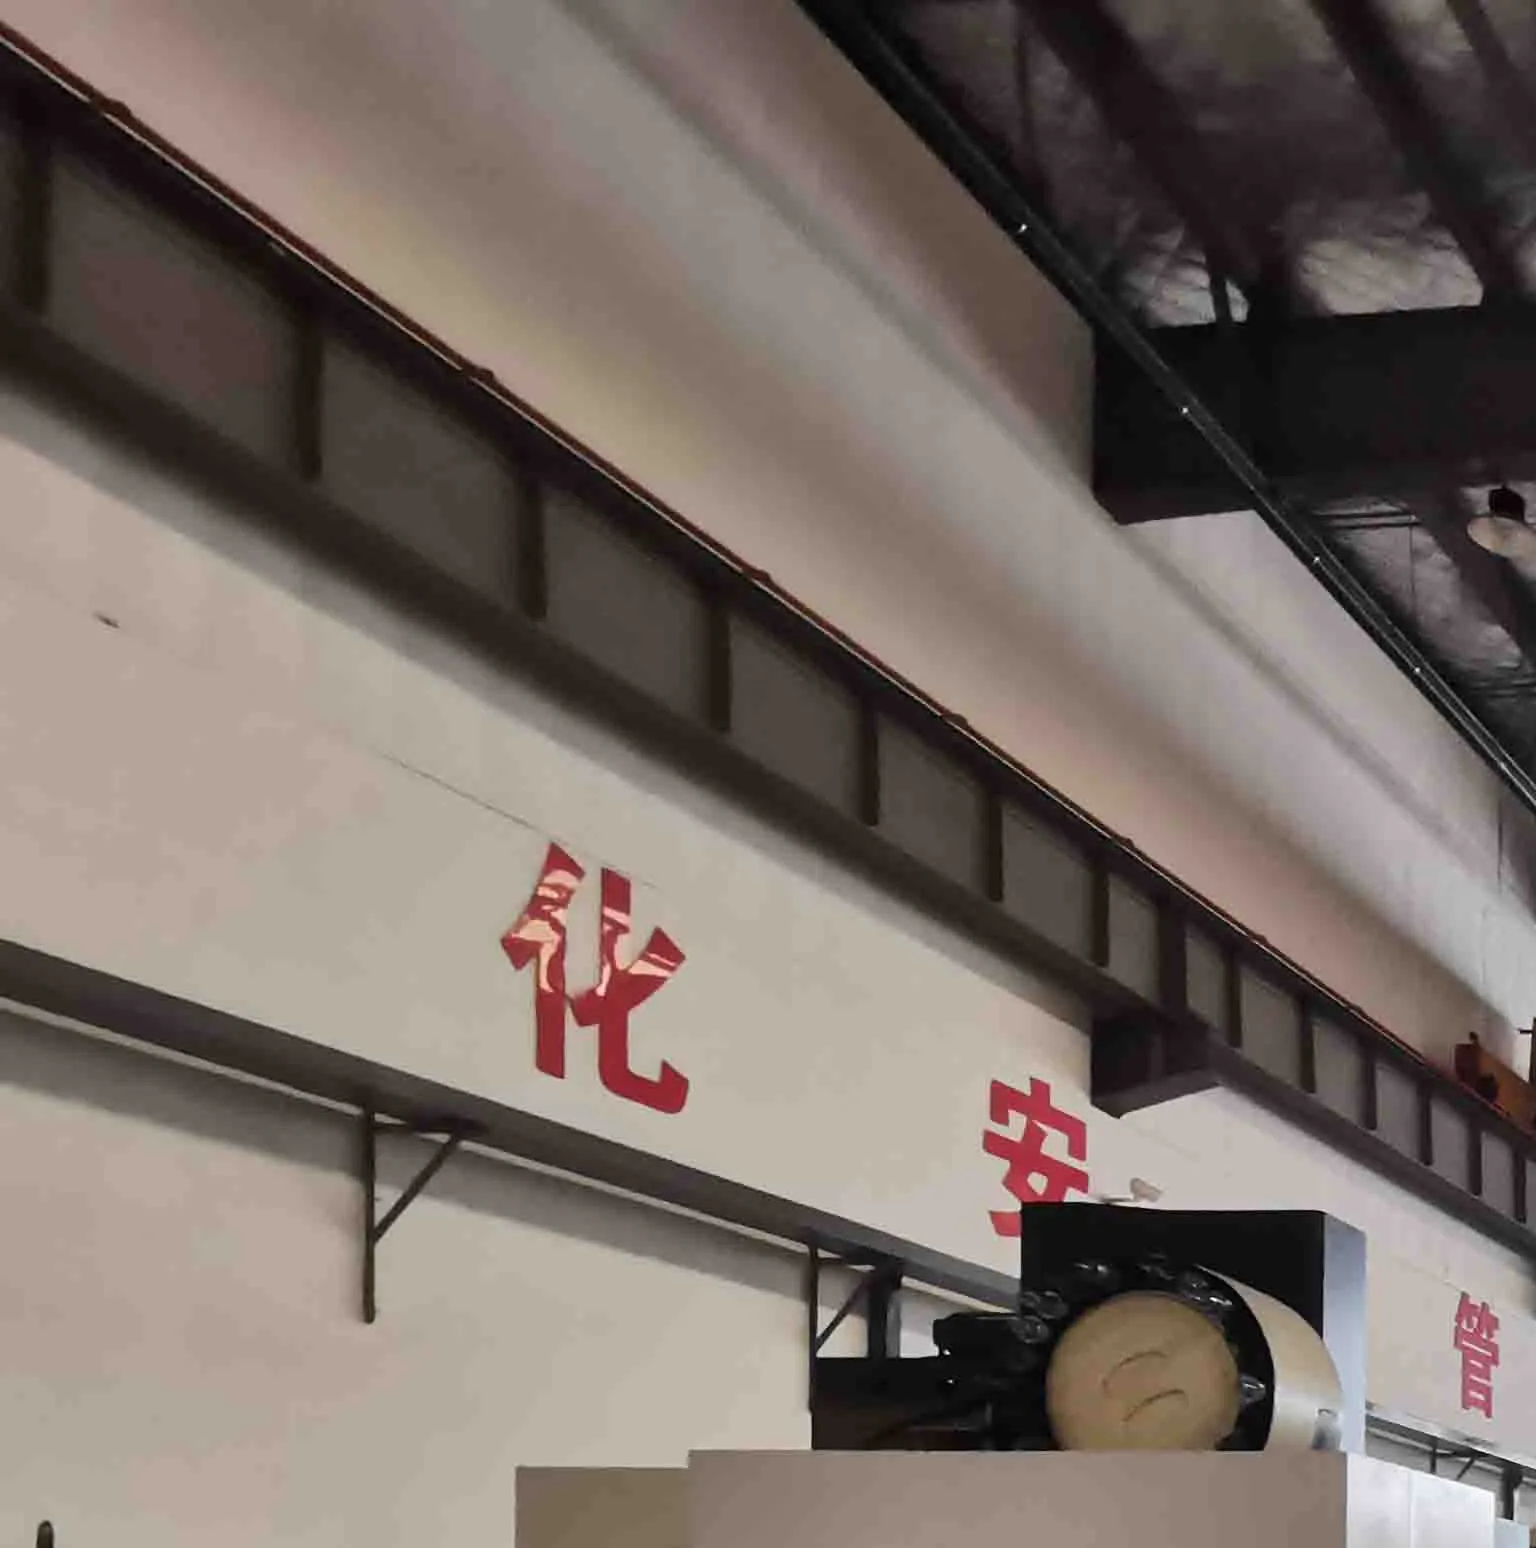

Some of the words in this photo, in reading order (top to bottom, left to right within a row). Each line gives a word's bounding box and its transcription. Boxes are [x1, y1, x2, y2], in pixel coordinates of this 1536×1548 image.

[500, 842, 690, 1114] 化
[983, 1076, 1090, 1238] 安
[1454, 1291, 1499, 1418] 管
